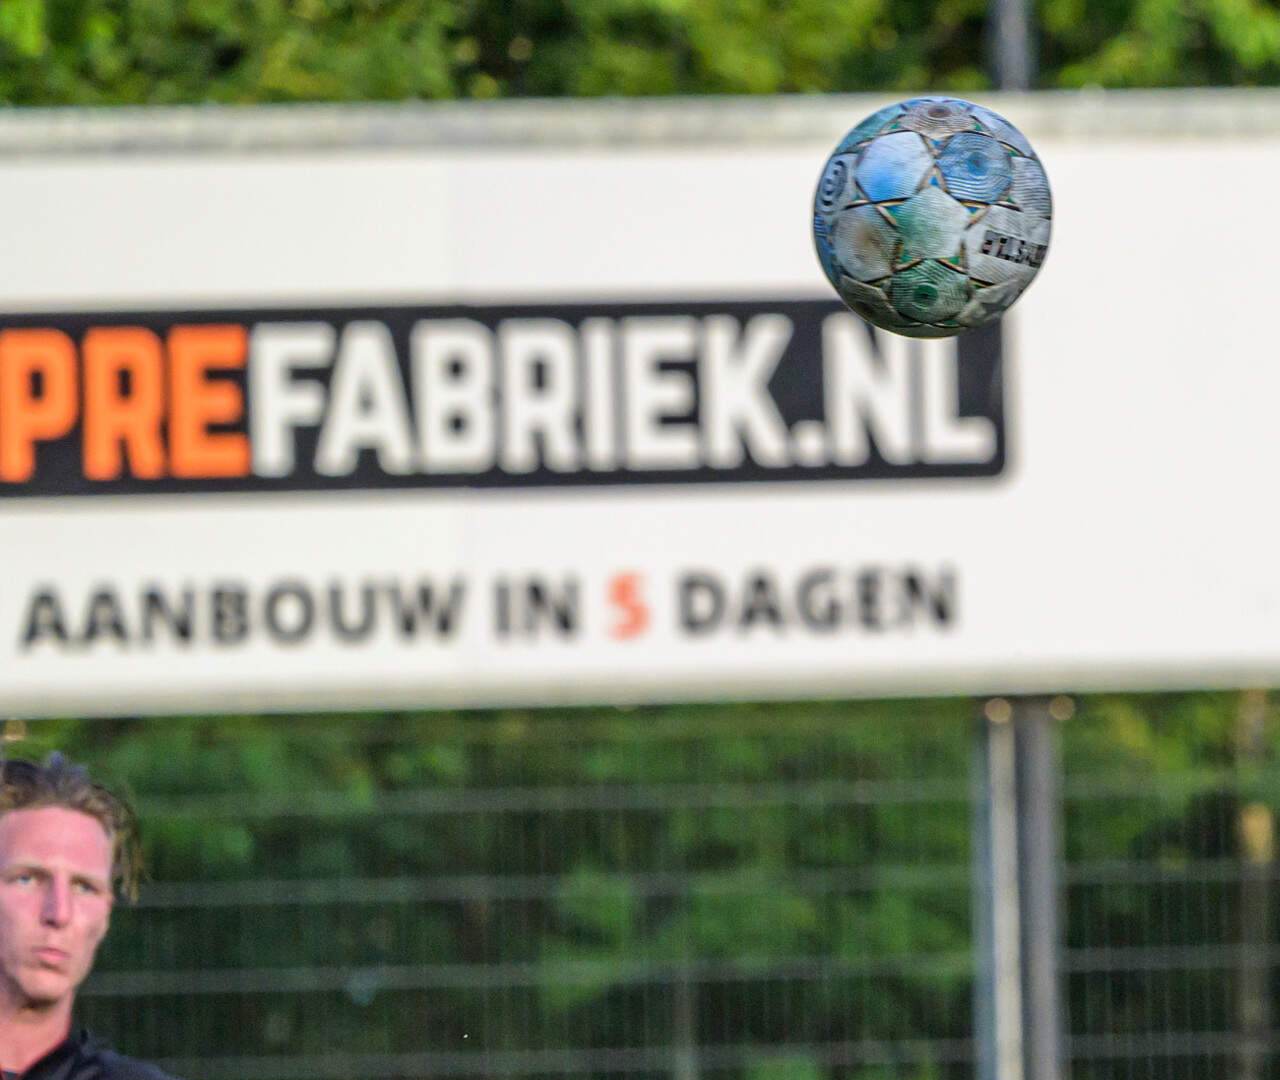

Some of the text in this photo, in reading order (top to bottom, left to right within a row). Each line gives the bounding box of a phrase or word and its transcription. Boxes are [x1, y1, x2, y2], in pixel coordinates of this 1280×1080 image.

[19, 565, 957, 651] AANBOUW IN 5 DAGEN
